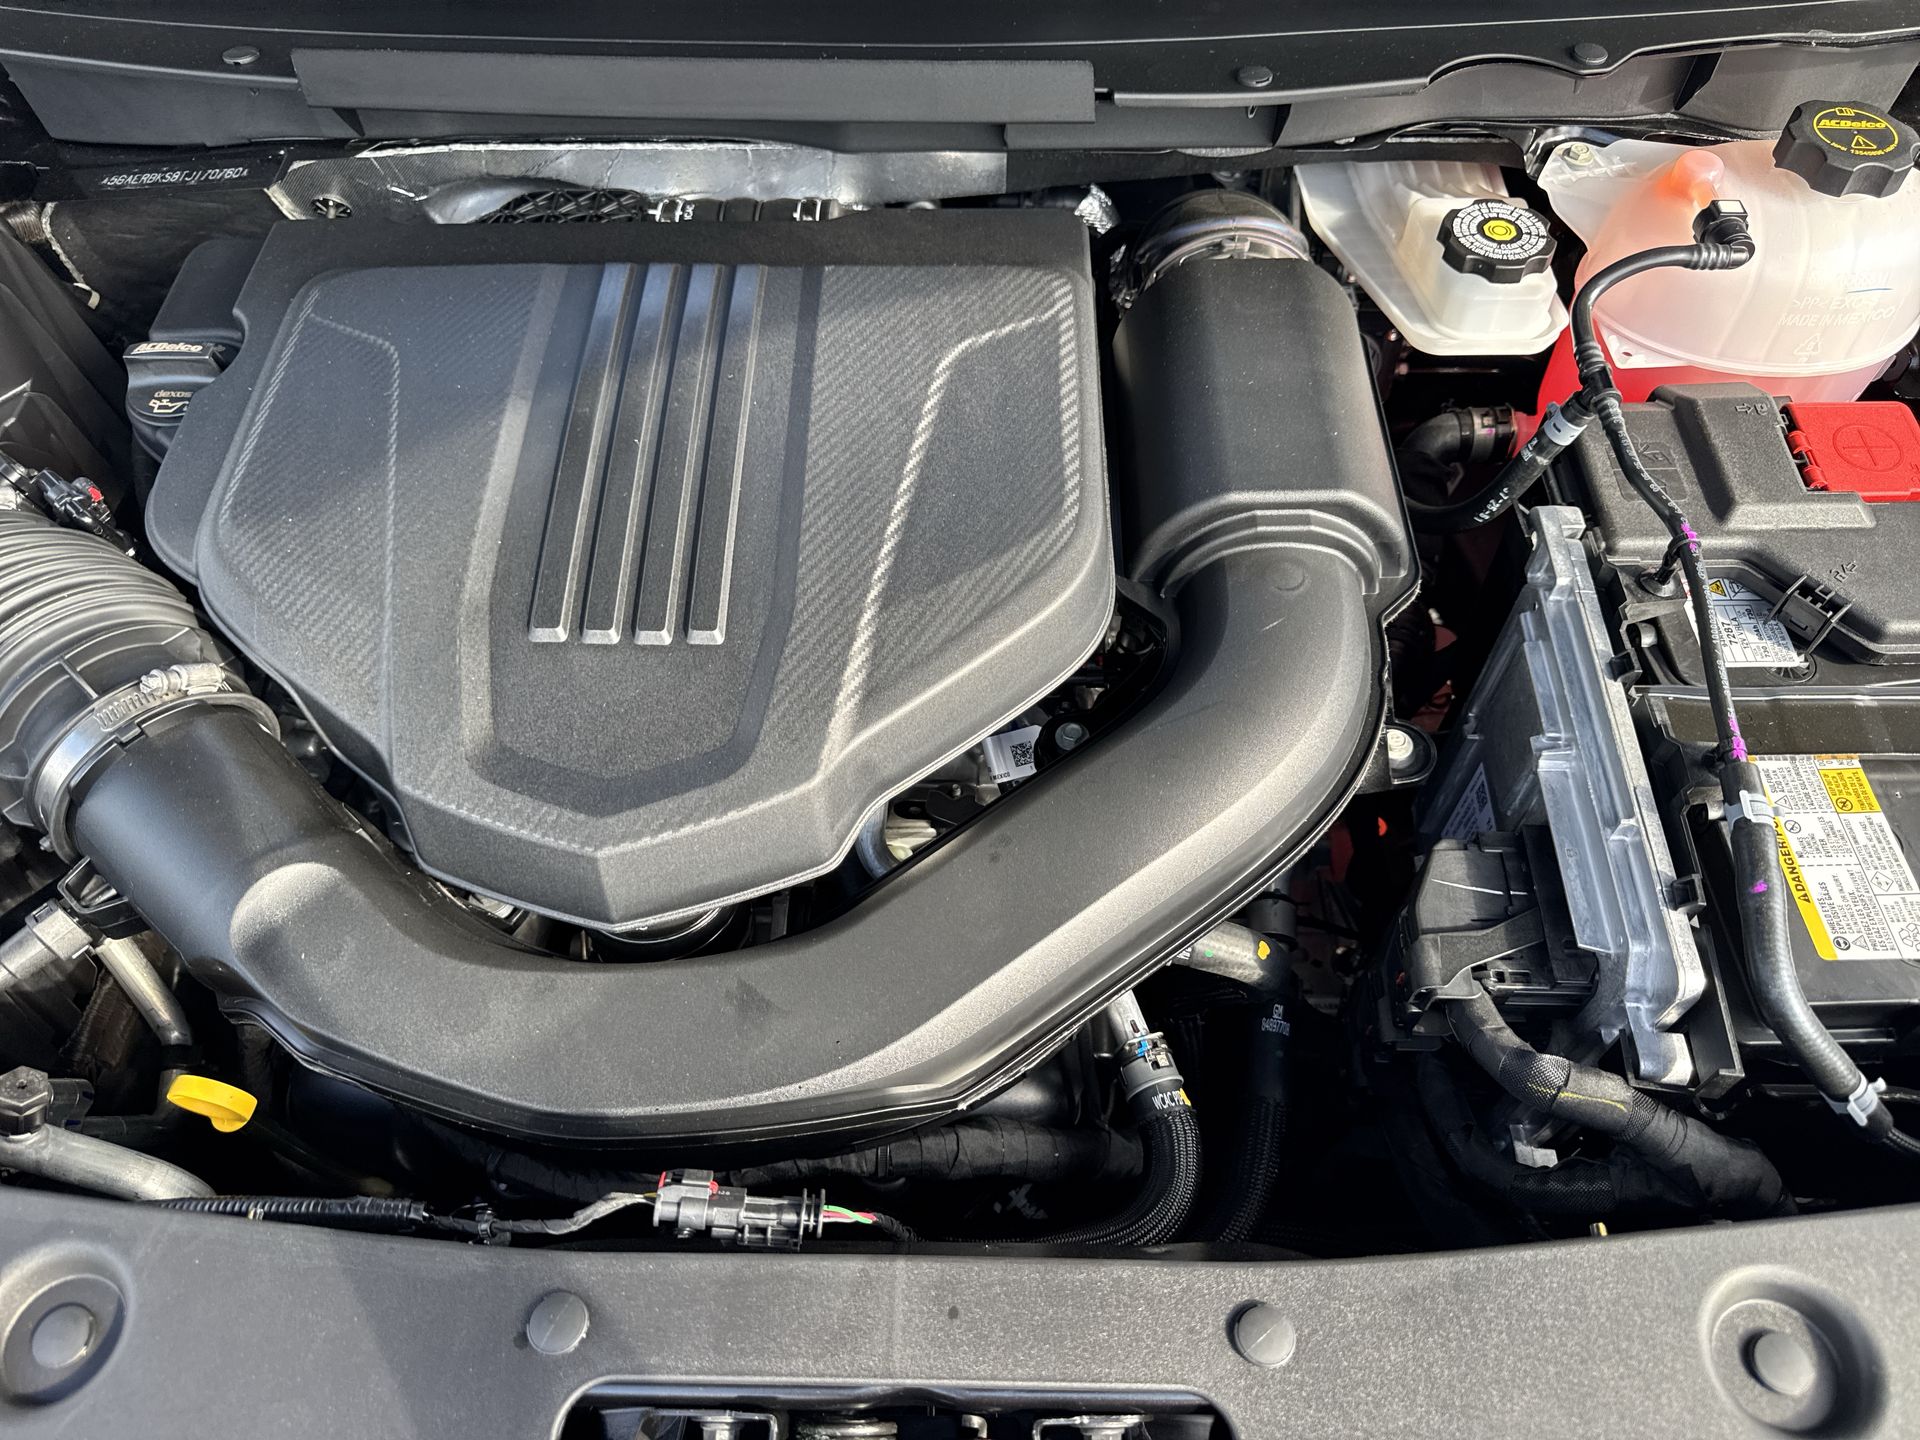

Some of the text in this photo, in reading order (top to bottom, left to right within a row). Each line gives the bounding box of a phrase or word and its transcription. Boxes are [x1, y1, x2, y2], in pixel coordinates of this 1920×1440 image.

[1818, 119, 1886, 129] ACDelco
[131, 343, 203, 354] ACDelco
[1745, 608, 1755, 620] 730
[1721, 622, 1738, 645] 7287
[1762, 768, 1778, 793] SULFURIC
[1771, 770, 1785, 793] ACID CAN
[1827, 902, 1847, 934] EXPLOSIVE
[1837, 904, 1855, 934] CAN CAUSE
[1855, 909, 1865, 919] LES
[1857, 894, 1877, 925] EXPLOSIFS
[1824, 914, 1839, 934] SHIELD
[1872, 927, 1882, 939] GAZ
[1878, 940, 1889, 951] LES
